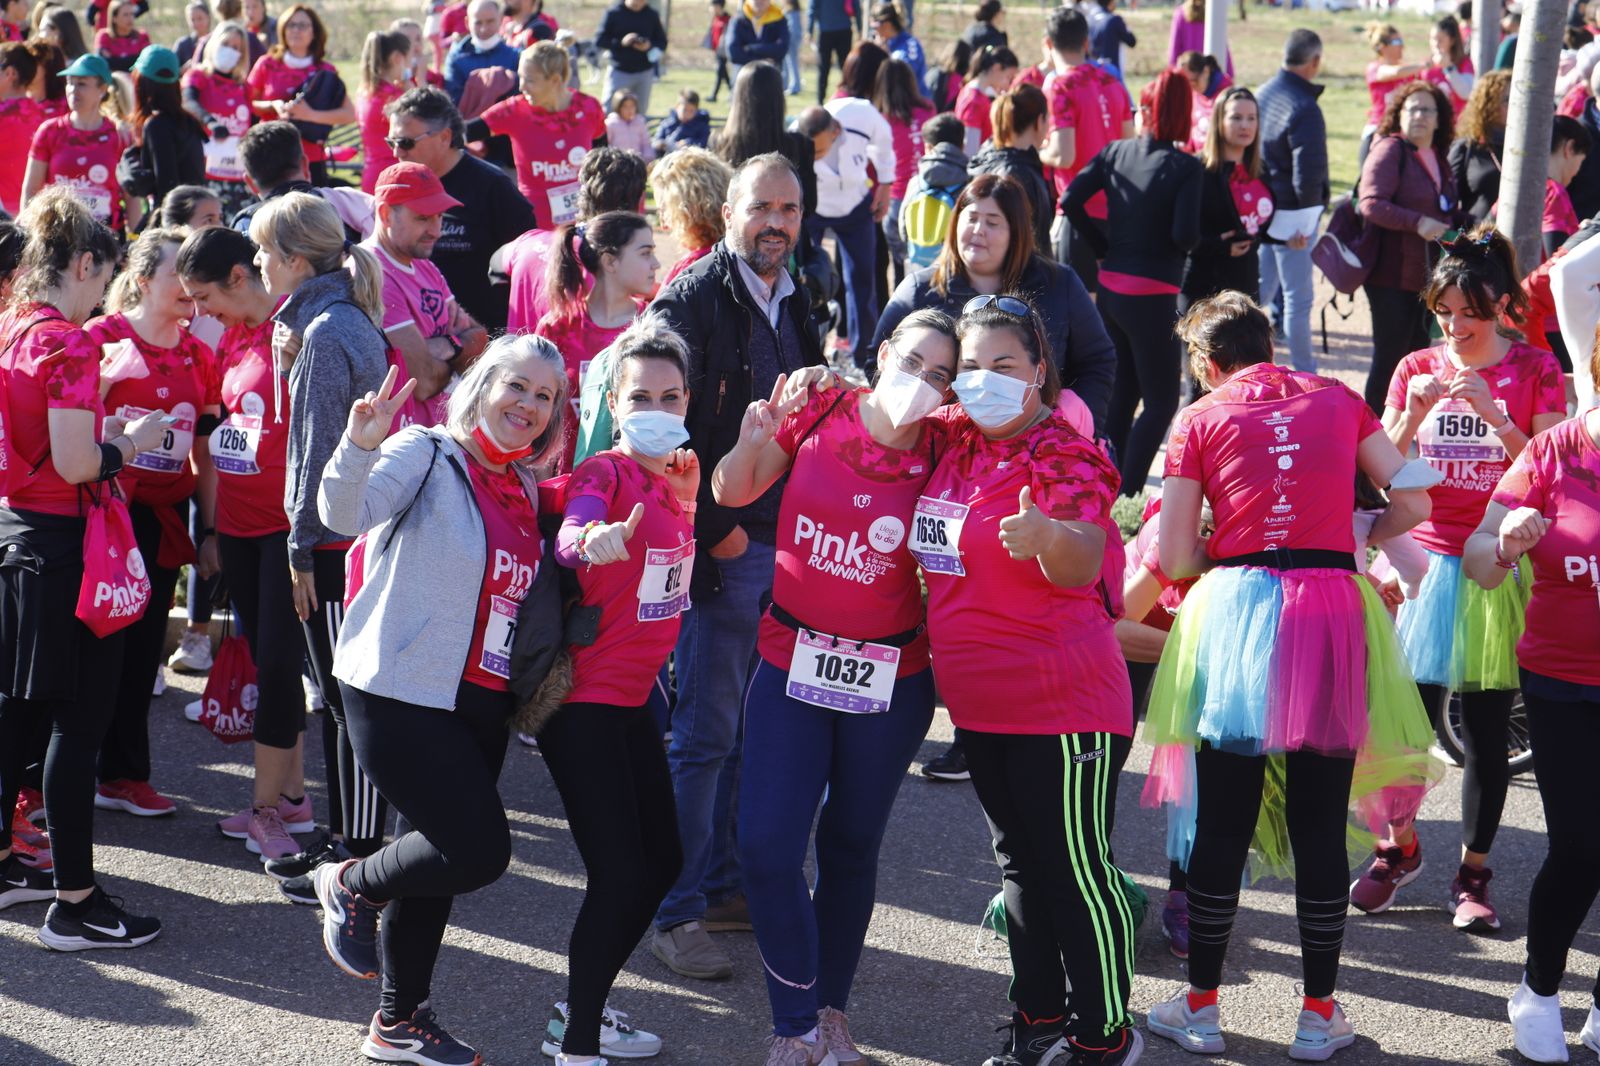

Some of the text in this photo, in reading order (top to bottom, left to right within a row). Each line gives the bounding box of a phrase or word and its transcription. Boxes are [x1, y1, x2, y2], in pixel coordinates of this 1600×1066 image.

[219, 428, 248, 452] 1268
[1436, 414, 1488, 438] 1596
[794, 513, 868, 570] Pink
[875, 532, 895, 545] tu día
[880, 524, 898, 536] Llegó
[916, 515, 948, 546] 1636
[493, 549, 540, 590] Pin
[665, 563, 682, 593] 812
[808, 553, 876, 585] RUNNING
[864, 562, 886, 576] 2022
[1564, 555, 1600, 583] Pi
[94, 576, 145, 608] Pink
[814, 652, 875, 688] 1032
[206, 698, 251, 732] Pink
